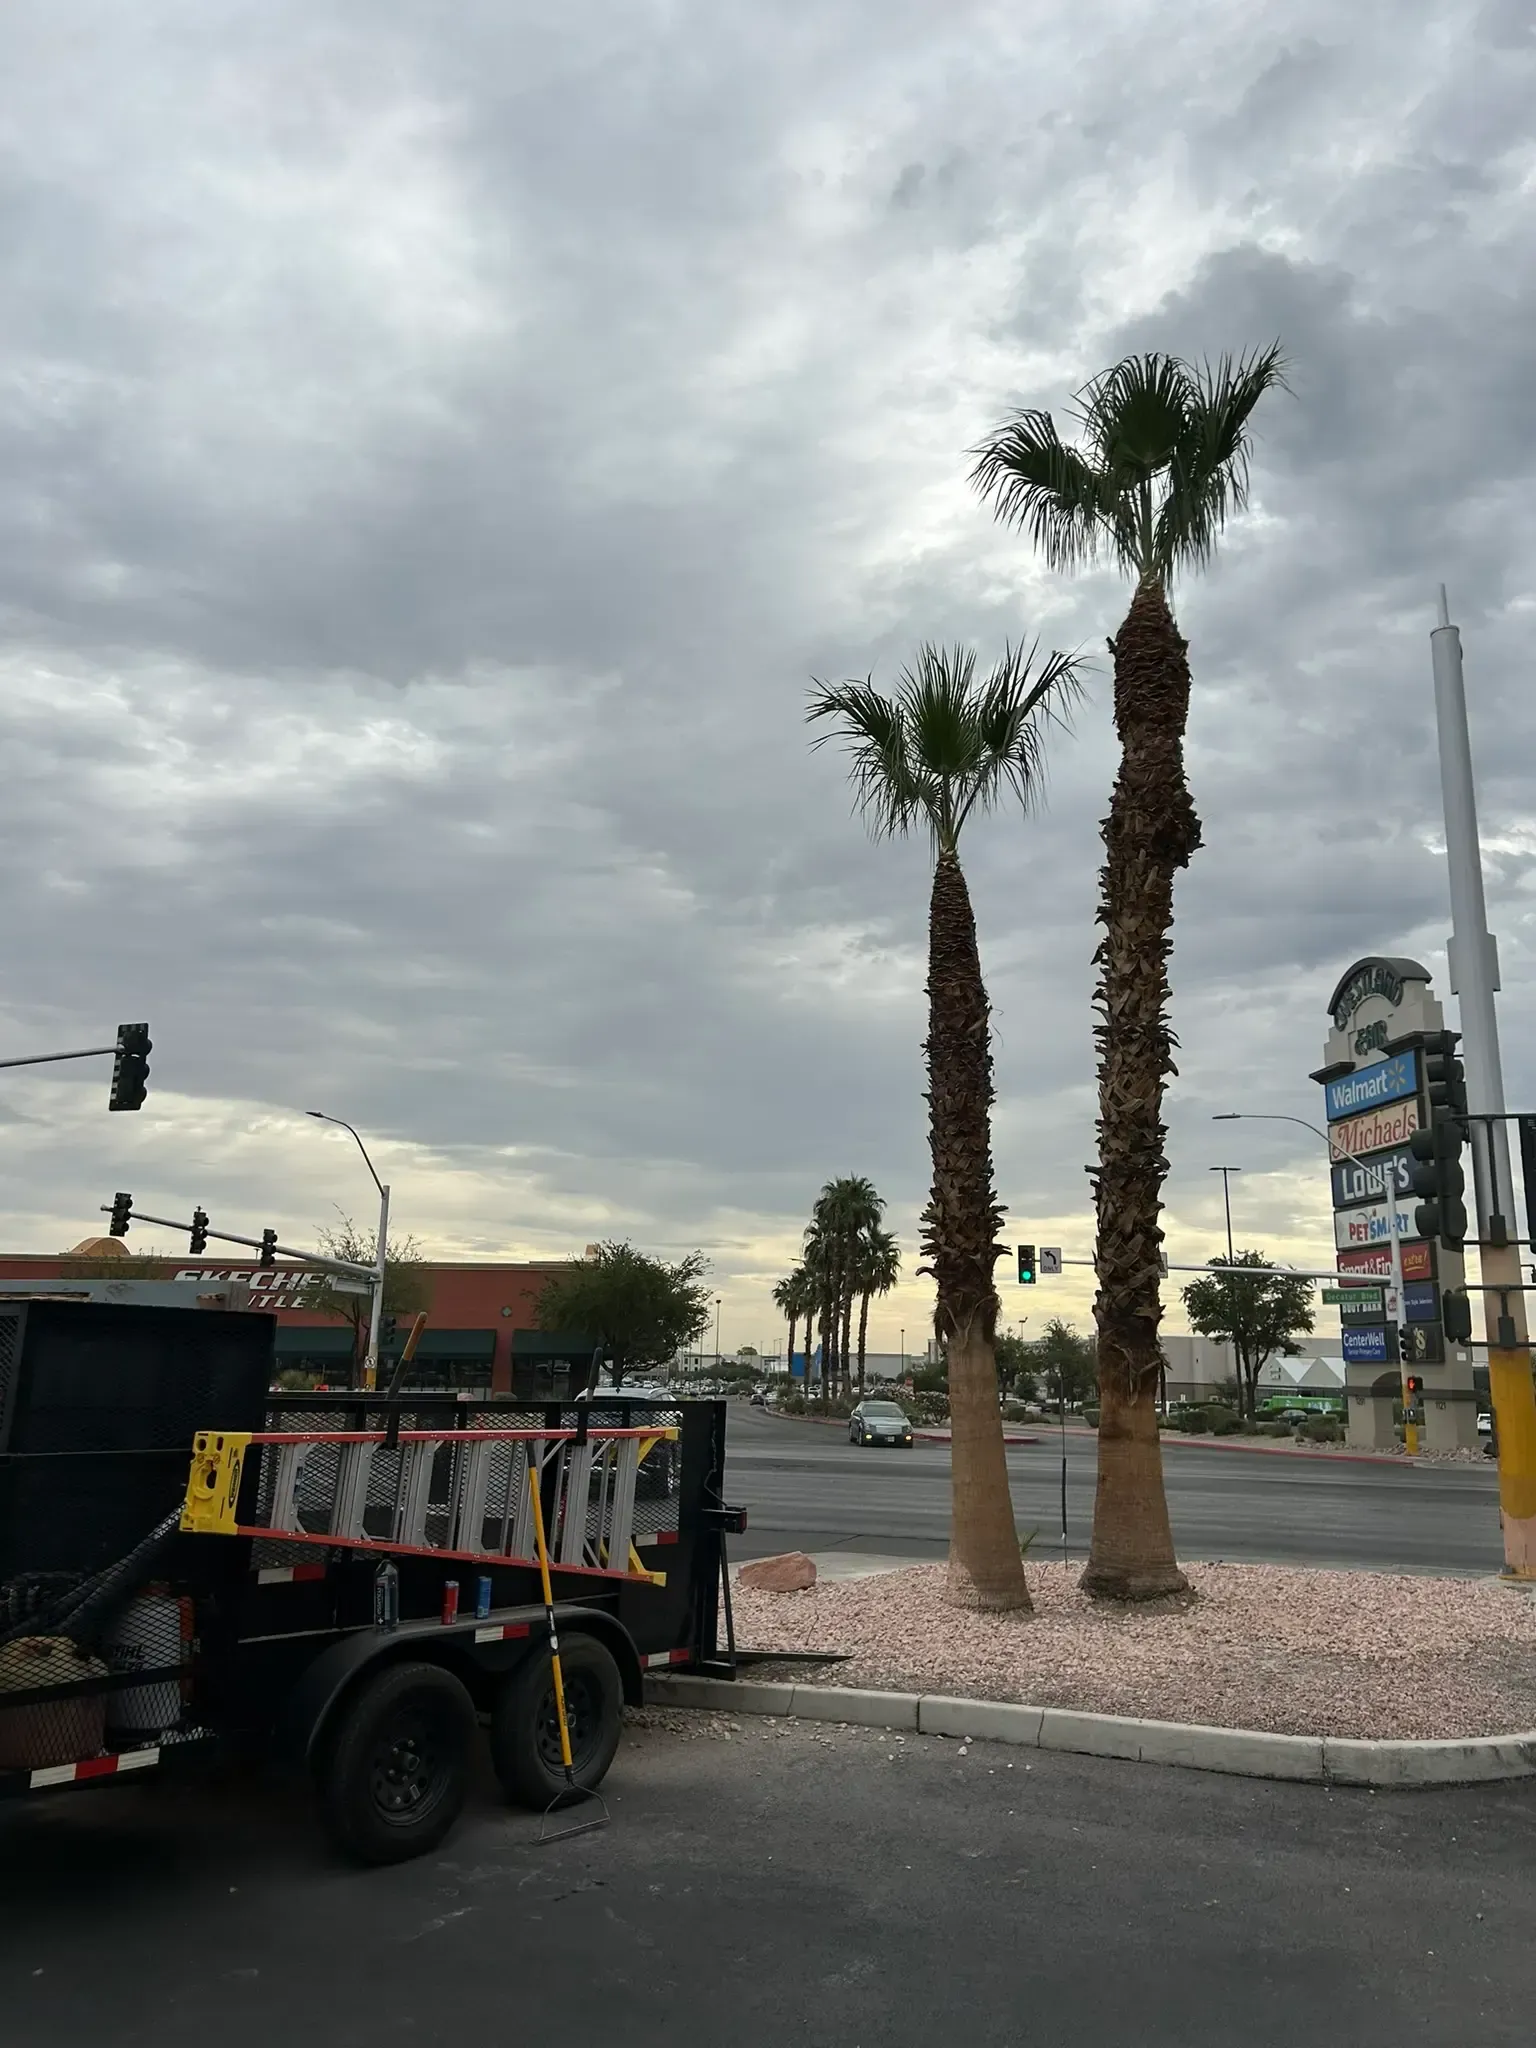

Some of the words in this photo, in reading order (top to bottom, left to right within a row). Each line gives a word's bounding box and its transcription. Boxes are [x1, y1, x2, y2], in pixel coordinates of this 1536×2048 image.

[1334, 967, 1404, 1032] WESTLAND
[1355, 1020, 1389, 1056] FAIR
[1332, 1069, 1389, 1109] Walmart
[1332, 1105, 1417, 1159] Michaels
[1342, 1155, 1410, 1200] LOWE'S
[173, 1269, 332, 1291] SKECHE
[1340, 1256, 1392, 1276] Smart&Fin
[1326, 1292, 1357, 1301] Decatur
[1361, 1291, 1379, 1300] Blvd
[1343, 1332, 1385, 1347] CenterWell
